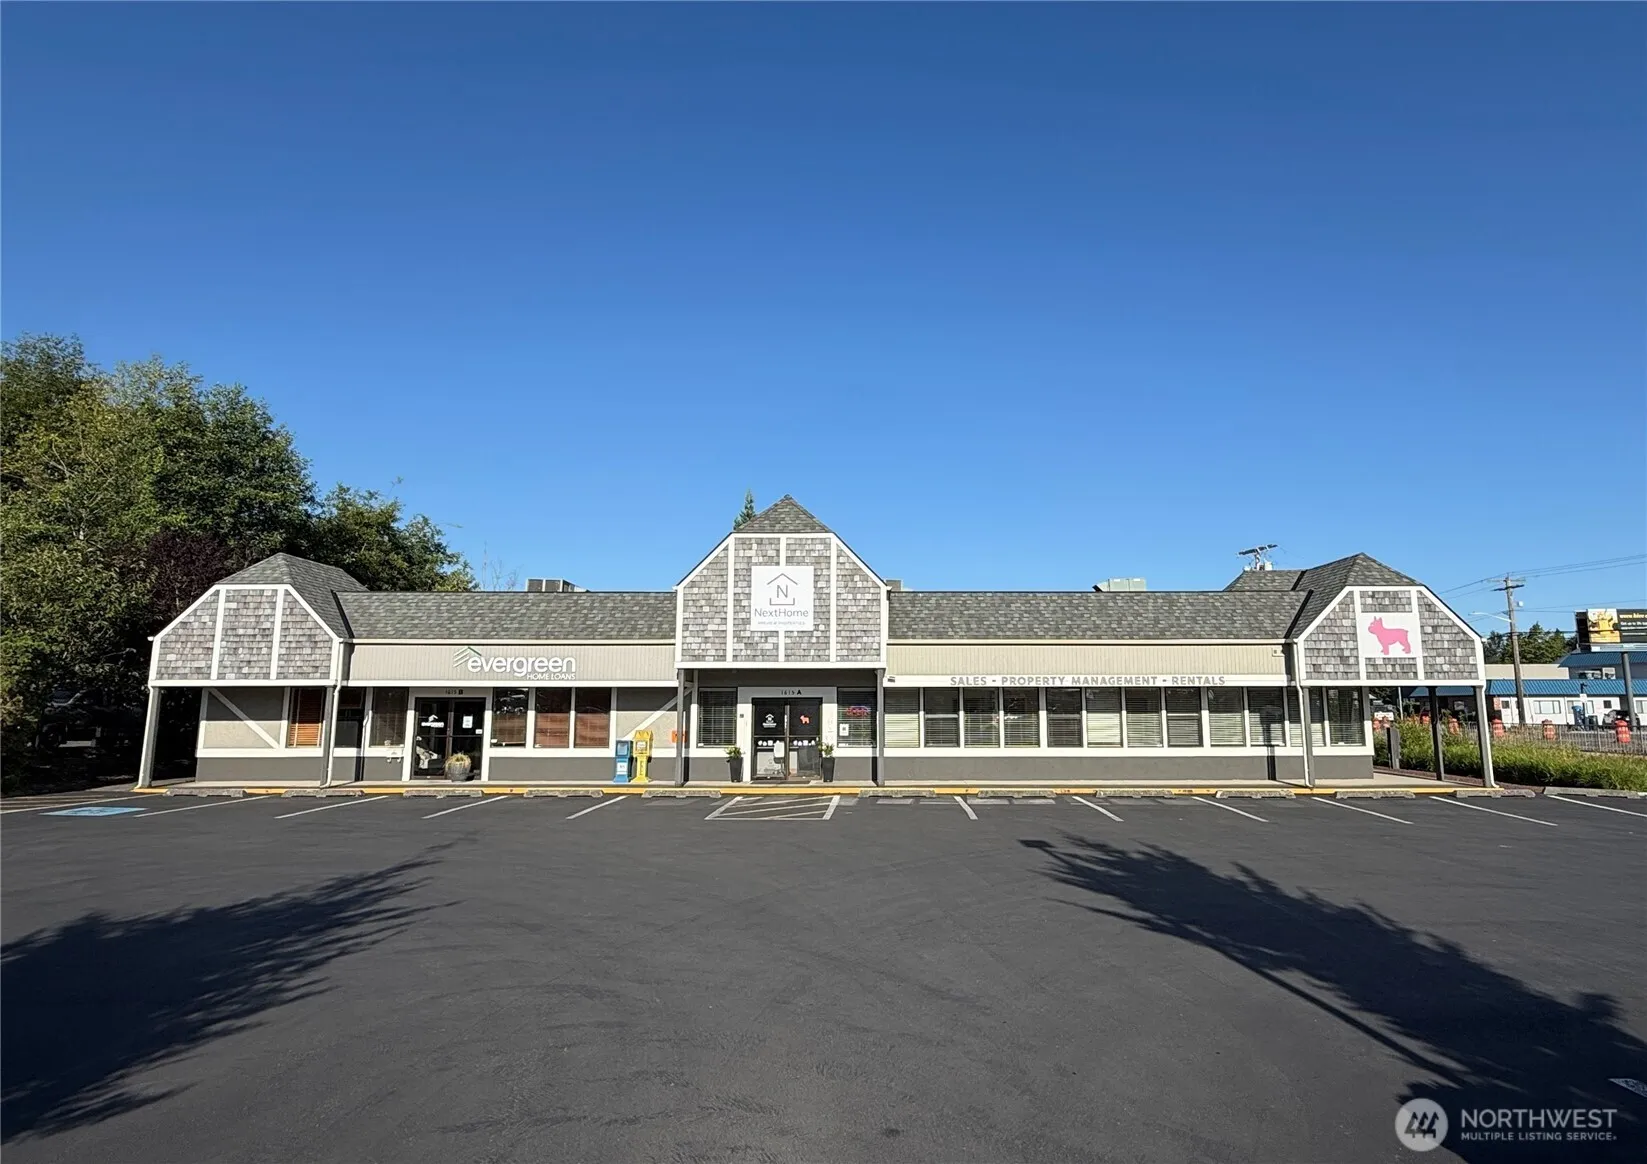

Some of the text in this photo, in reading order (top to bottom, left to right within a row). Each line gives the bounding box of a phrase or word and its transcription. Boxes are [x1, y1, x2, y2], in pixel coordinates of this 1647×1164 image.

[776, 584, 789, 599] N
[754, 608, 809, 618] NextHome
[467, 656, 576, 677] evergreen
[950, 676, 987, 686] SALES
[1001, 676, 1065, 686] PROPERTY
[1071, 676, 1158, 686] MANAGEMENT
[1172, 676, 1226, 686] RENTALS
